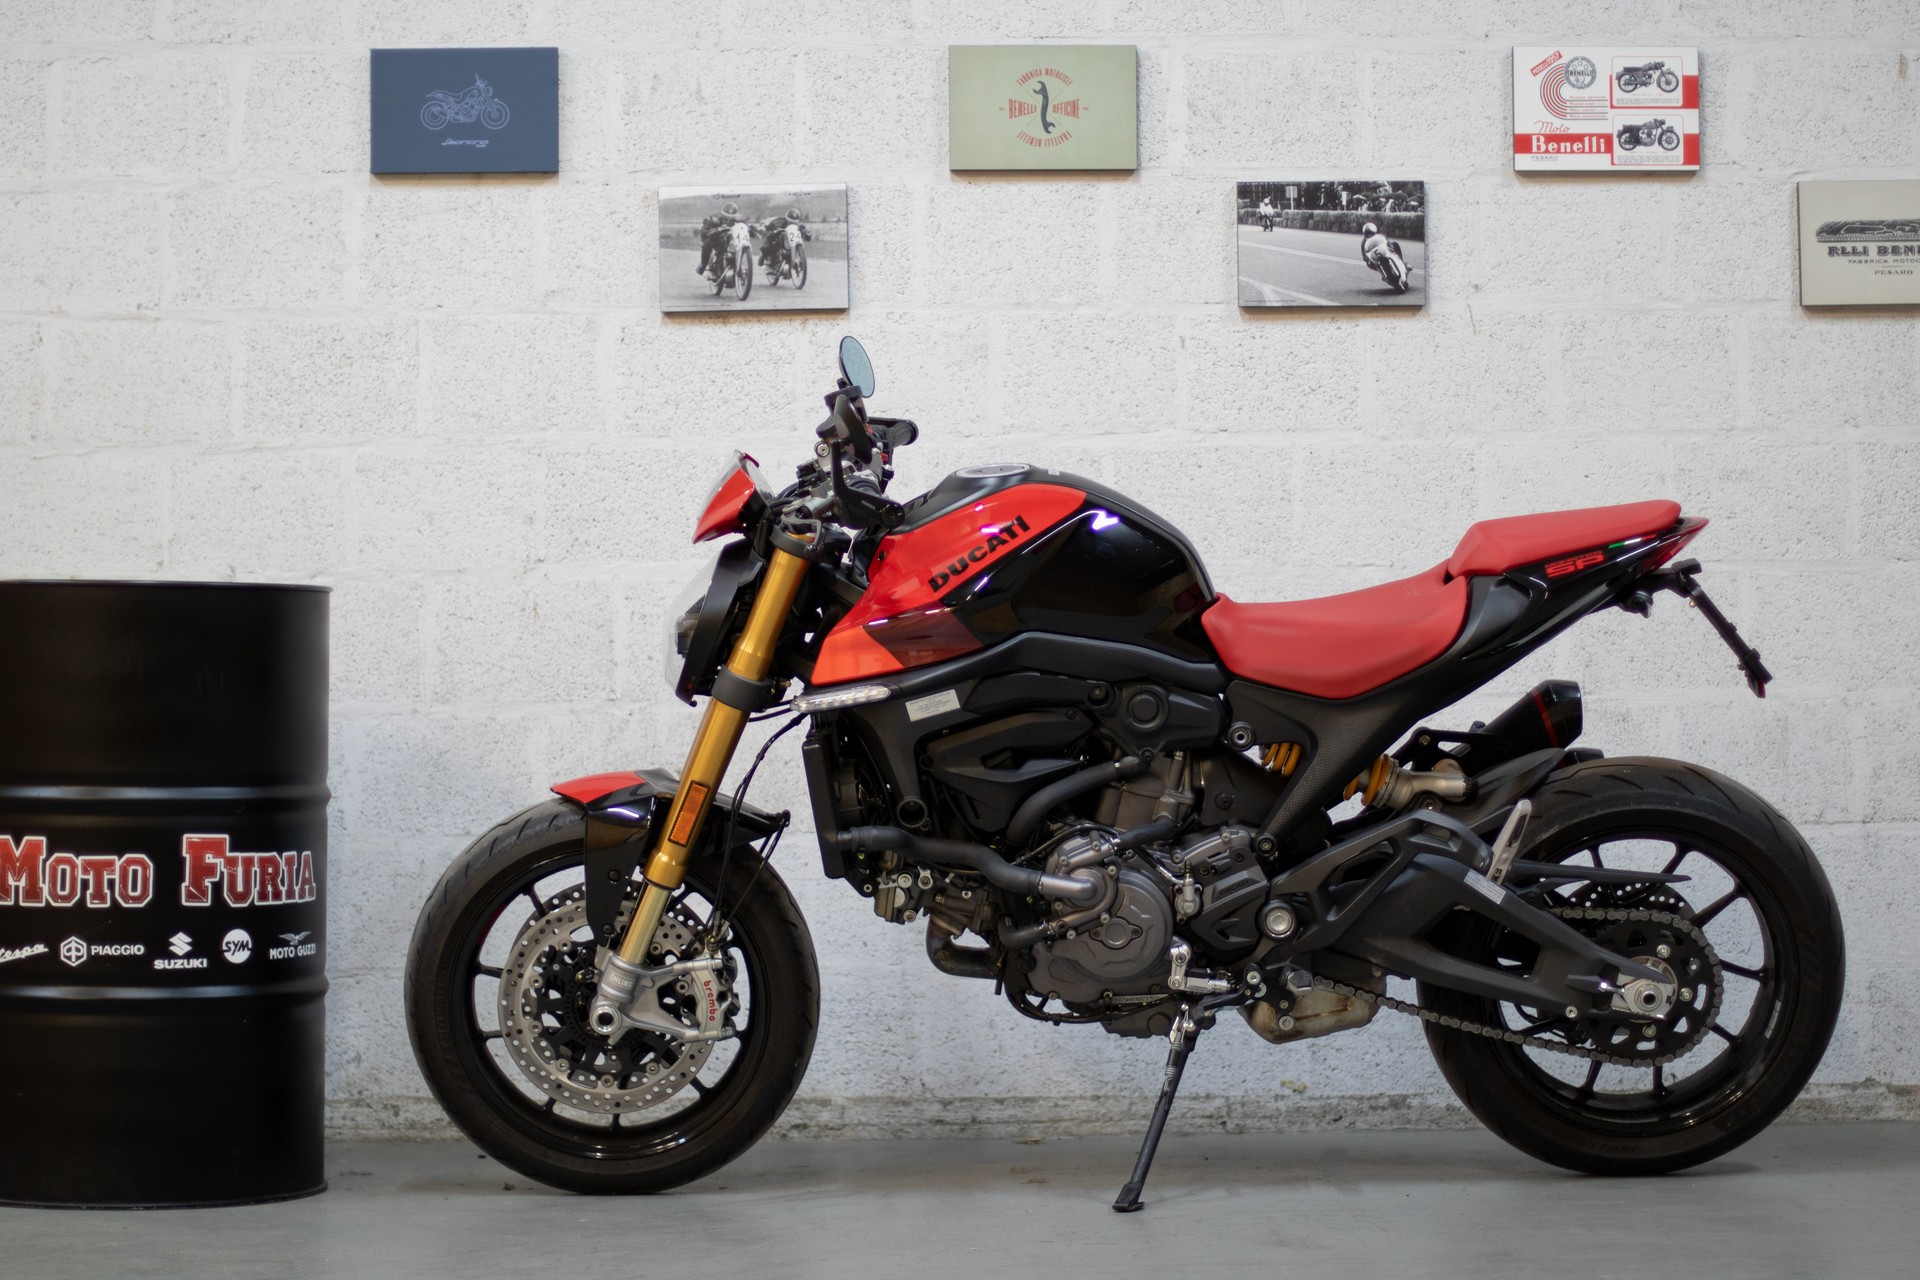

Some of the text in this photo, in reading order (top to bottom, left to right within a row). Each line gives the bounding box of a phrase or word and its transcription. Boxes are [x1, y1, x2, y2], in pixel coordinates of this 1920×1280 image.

[1008, 98, 1037, 119] BENELLI
[1052, 98, 1080, 119] OFFICINE
[1534, 120, 1570, 133] Moto
[1531, 134, 1605, 153] Benelli
[1877, 244, 1920, 256] BEN
[927, 514, 1031, 593] DUCATI
[1546, 553, 1604, 578] SP
[90, 944, 145, 956] PIAGGIO
[269, 943, 316, 960] MOTO GUZZI
[153, 957, 208, 970] SUZUKI
[704, 980, 717, 1021] brembo
